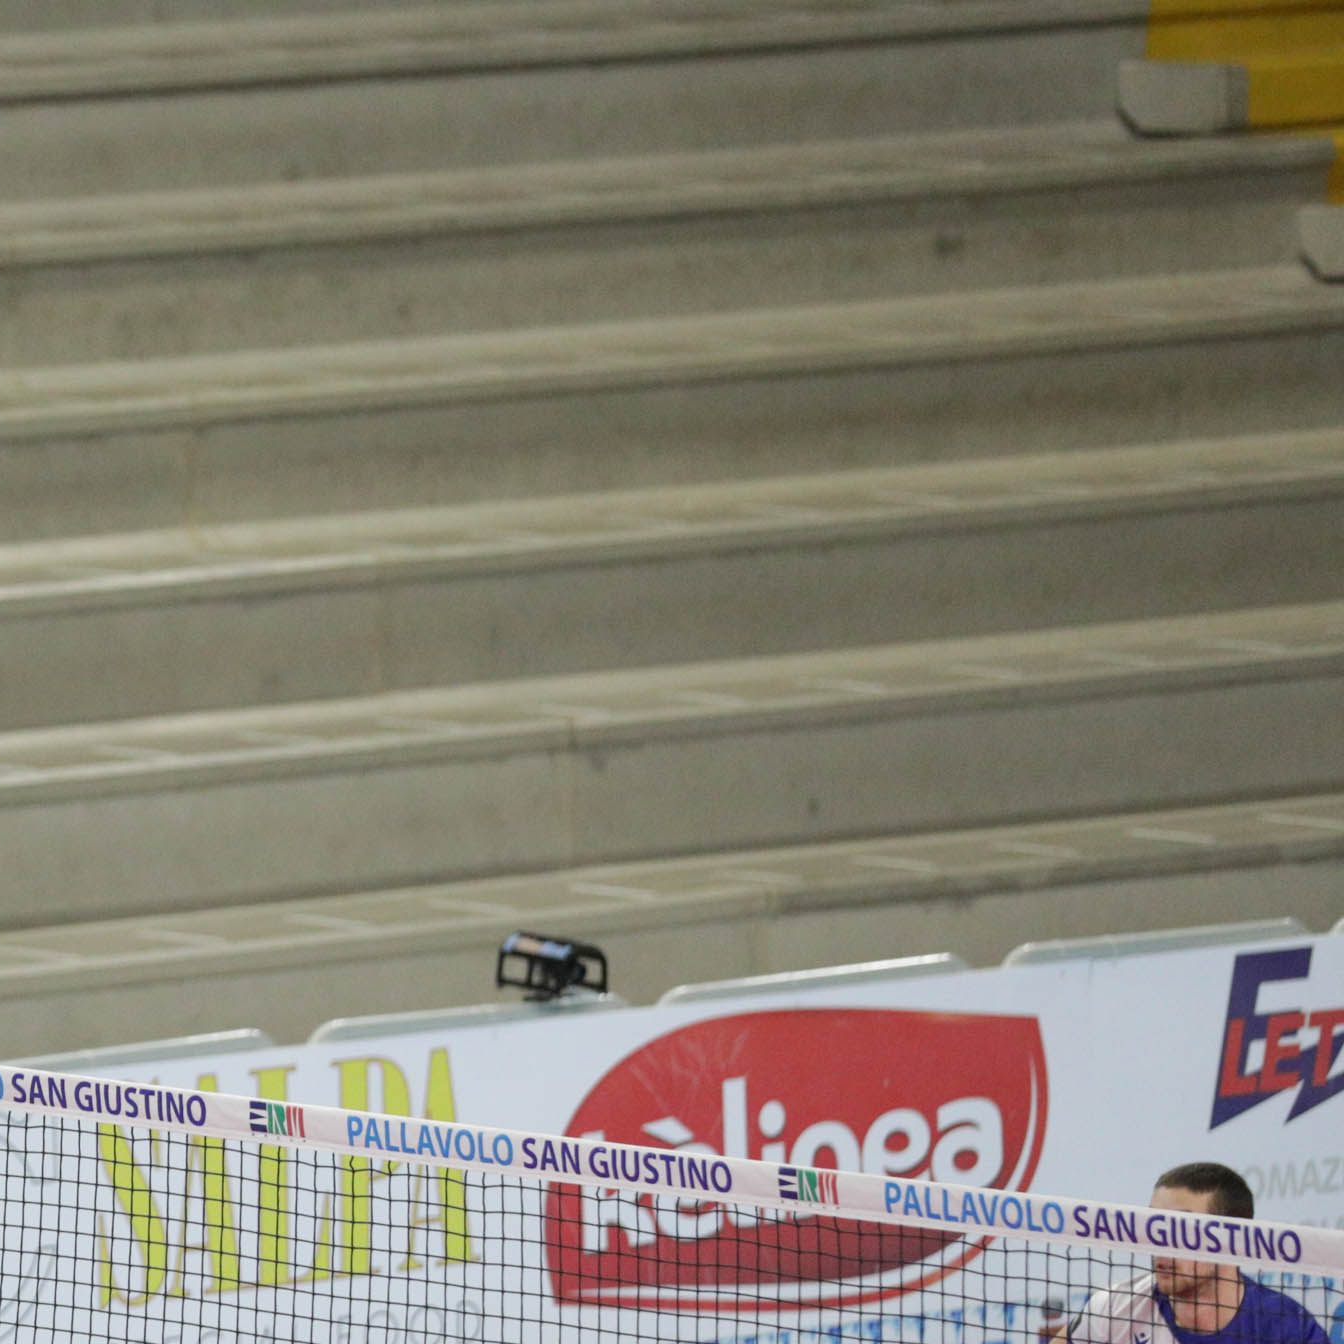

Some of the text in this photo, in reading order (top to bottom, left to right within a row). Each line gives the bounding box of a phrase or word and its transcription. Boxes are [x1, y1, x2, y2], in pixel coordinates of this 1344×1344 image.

[12, 1072, 66, 1110] SAN
[74, 1080, 207, 1127] GIUSTINO
[97, 1045, 481, 1310] SALPA
[347, 1114, 733, 1194] PALLAVOLO SAN GIUSTINO
[884, 1182, 1302, 1264] PALLAVOLO SAN GIUSTINO
